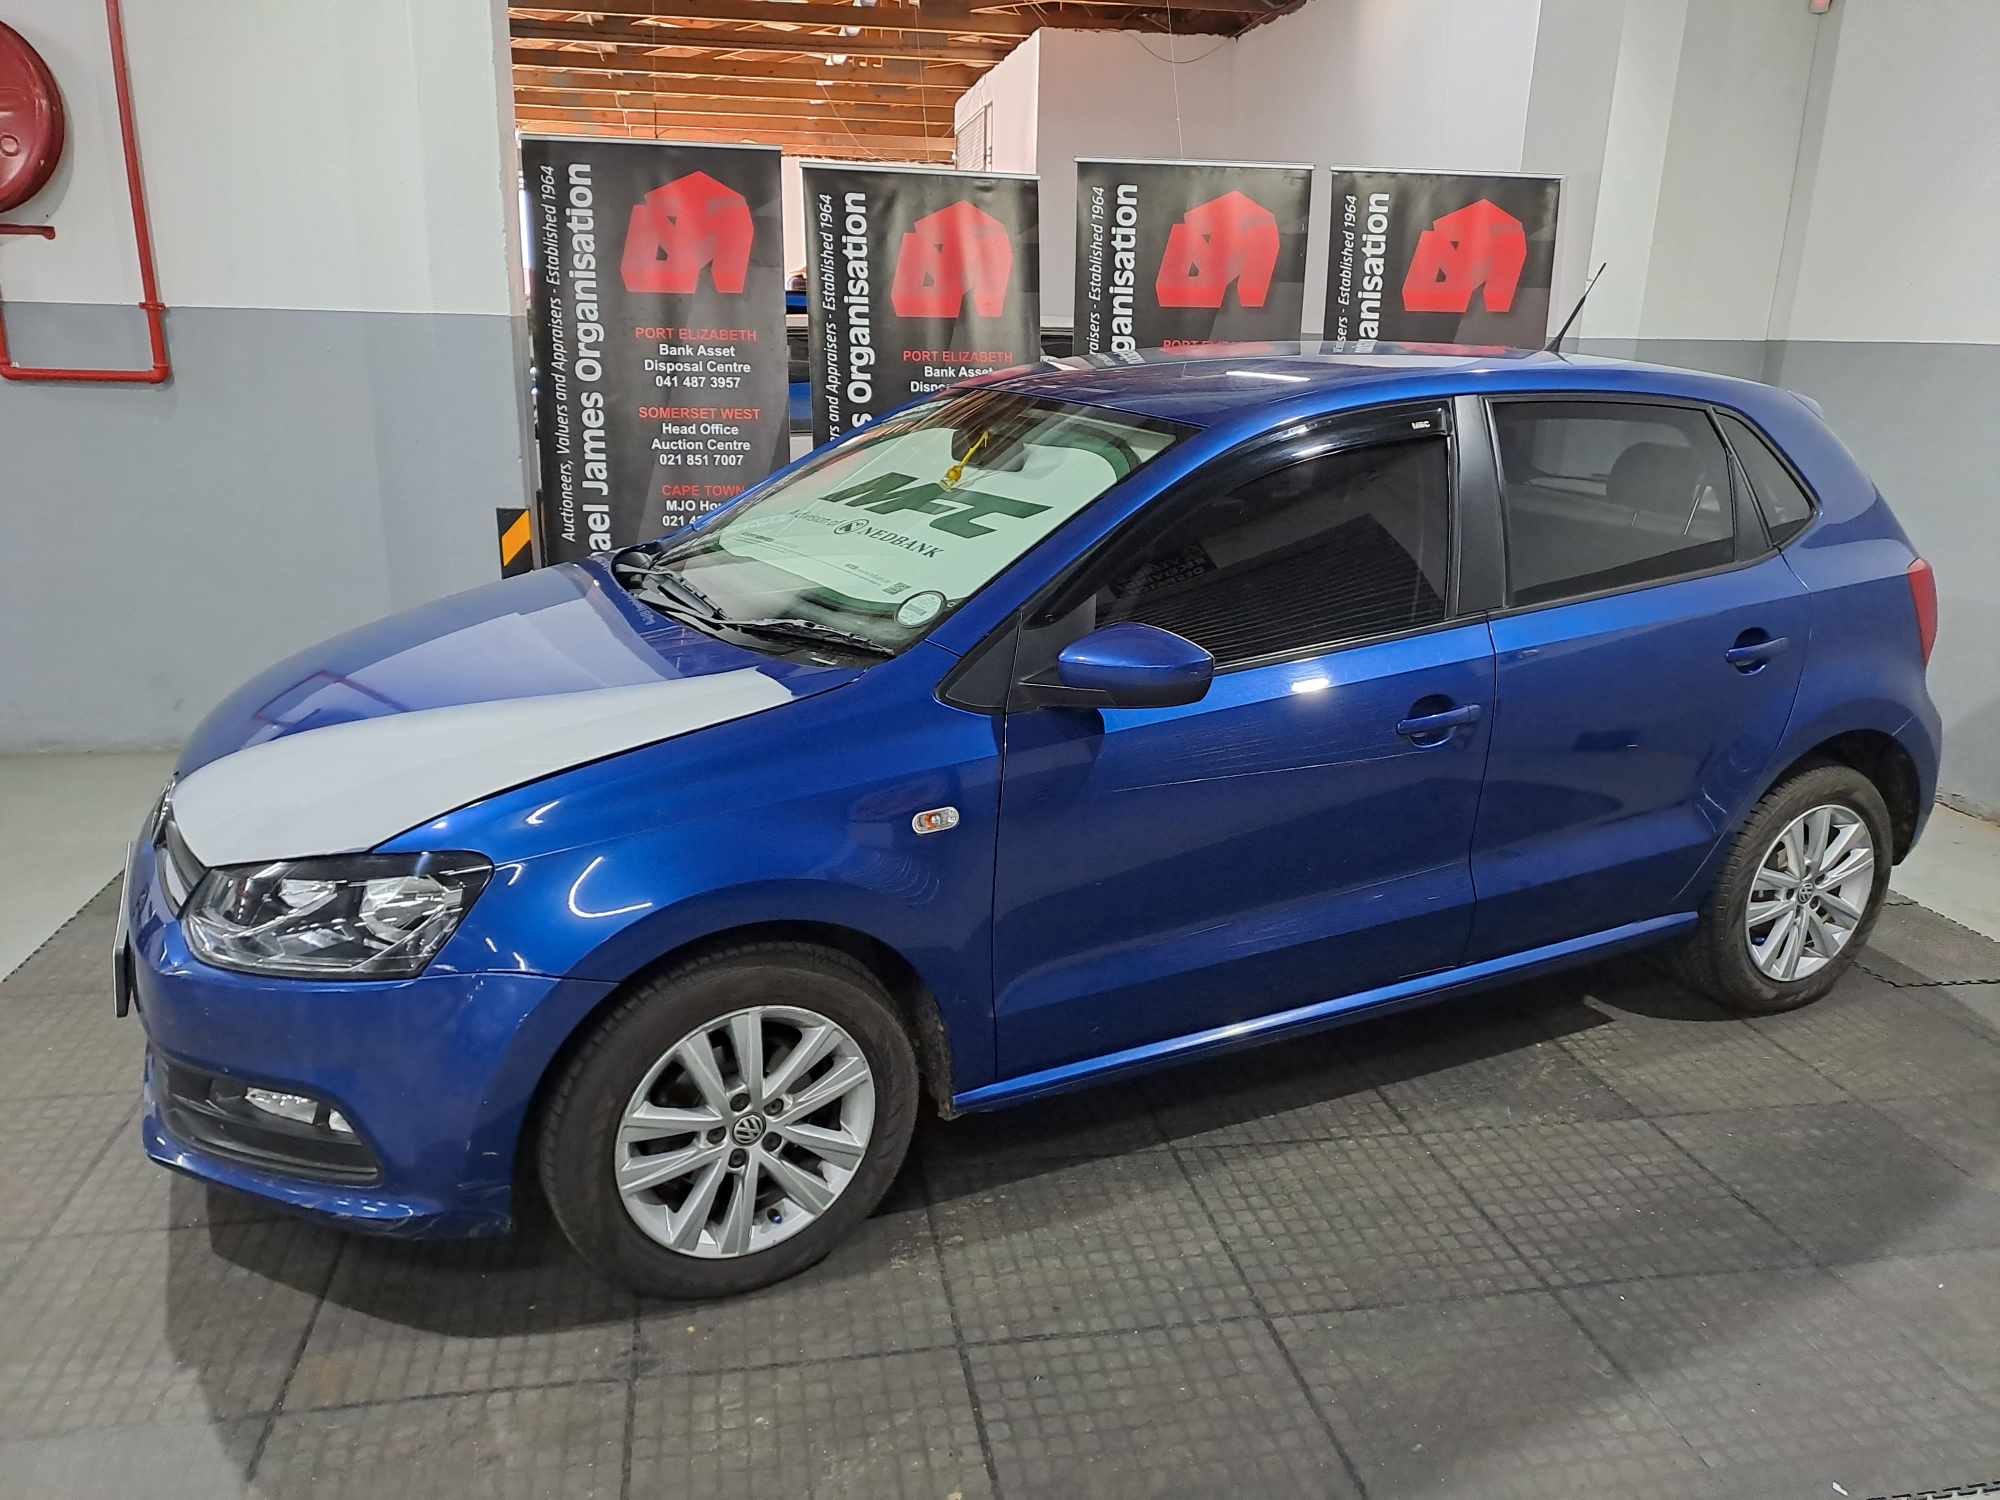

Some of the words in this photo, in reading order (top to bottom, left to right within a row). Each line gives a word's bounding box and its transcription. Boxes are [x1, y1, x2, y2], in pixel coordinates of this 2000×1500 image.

[540, 165, 556, 200] 1964
[819, 193, 833, 228] 1964
[1091, 187, 1104, 219] 1964
[1344, 194, 1357, 227] 1964
[541, 204, 561, 285] Established
[565, 163, 605, 382] Organisation
[820, 232, 836, 311] Established
[1089, 223, 1103, 301] Established
[1338, 231, 1355, 305] Established
[842, 192, 876, 404] Organisation
[550, 297, 569, 372] Appraisers
[635, 327, 674, 339] PORT
[679, 328, 758, 341] ELIZABETH
[659, 344, 694, 356] Bank
[697, 345, 736, 357] Asset
[824, 322, 841, 394] Appraisers
[903, 350, 939, 361] PORT
[943, 351, 1014, 362] ELIZABETH
[644, 360, 703, 374] Disposal
[706, 361, 751, 373] Centre
[655, 376, 679, 387] 041
[682, 376, 706, 388] 487
[710, 377, 741, 388] 3957
[924, 366, 956, 377] Bank
[551, 373, 567, 400] and
[639, 407, 716, 419] SOMERSET
[720, 408, 760, 419] WEST
[825, 395, 840, 422] and
[554, 404, 570, 454] Valuers
[581, 391, 609, 496] James
[651, 439, 703, 450] Auction
[707, 440, 751, 451] Centre
[662, 423, 696, 435] Head
[700, 424, 739, 435] Office
[660, 454, 682, 465] 021
[686, 455, 709, 466] 851
[713, 455, 744, 466] 7007
[559, 460, 575, 542] Auctioneers,
[662, 485, 699, 496] CAPE
[666, 501, 696, 511] MJO
[662, 516, 685, 526] 021
[857, 526, 945, 559] NEDBANK
